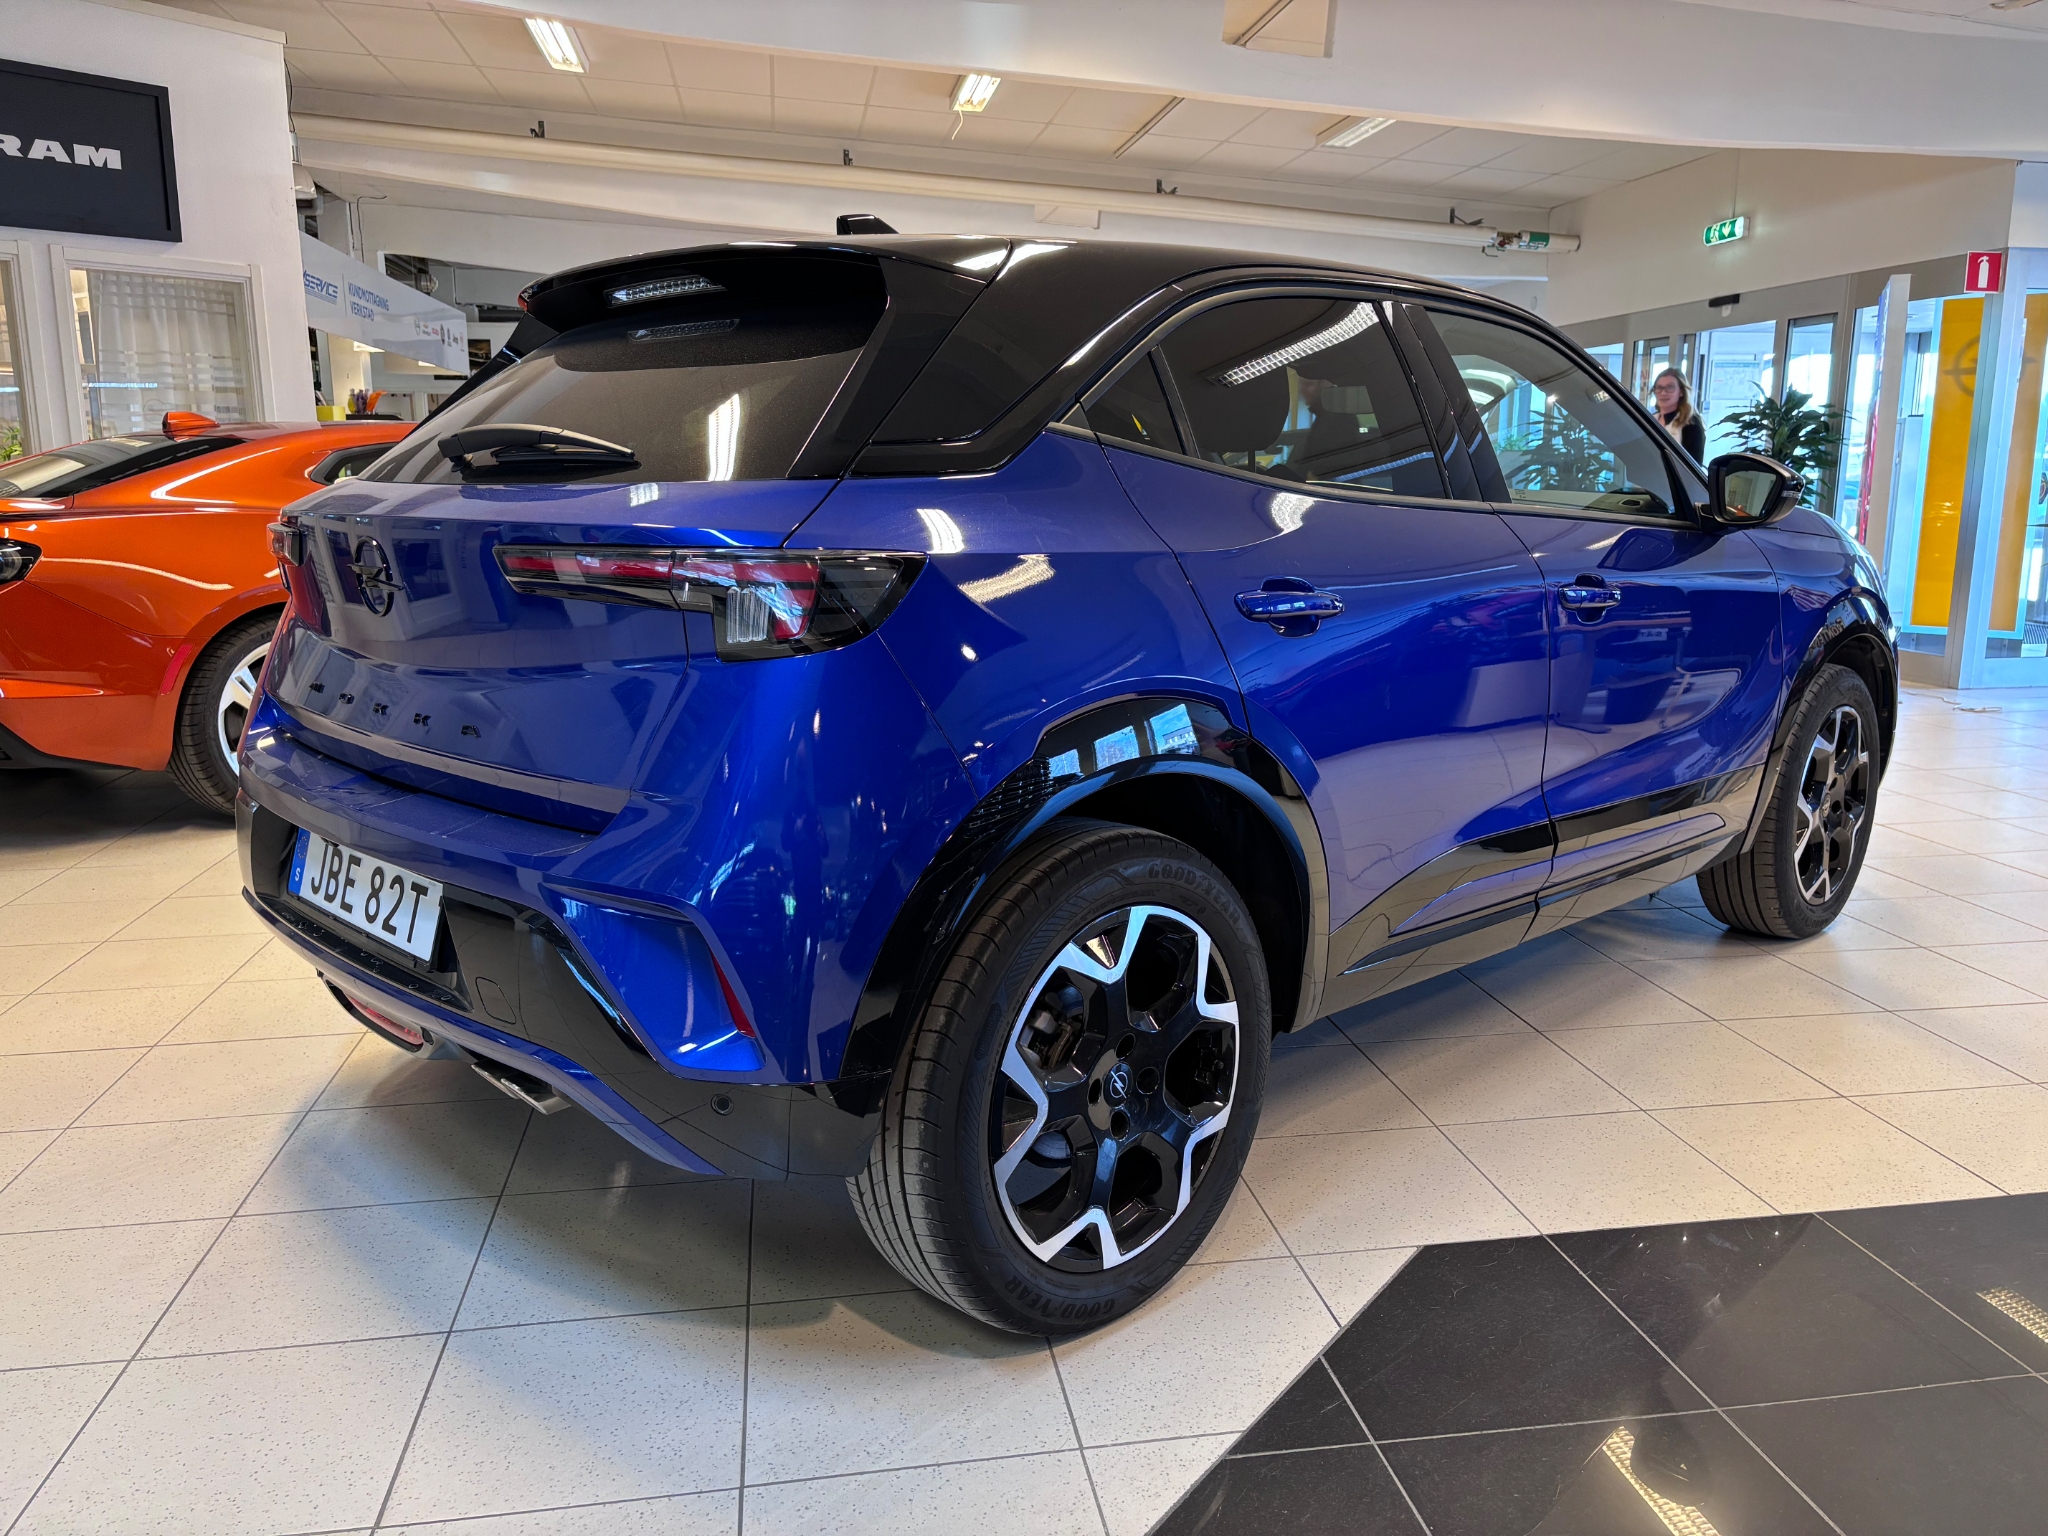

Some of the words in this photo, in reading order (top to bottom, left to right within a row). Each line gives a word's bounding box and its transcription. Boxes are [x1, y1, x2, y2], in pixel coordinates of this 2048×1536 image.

[0, 134, 122, 170] RAM
[302, 270, 338, 299] SERVICE
[350, 300, 374, 321] VERKSTAD
[294, 867, 301, 882] S
[311, 844, 362, 914] JBE
[365, 866, 429, 944] 82T
